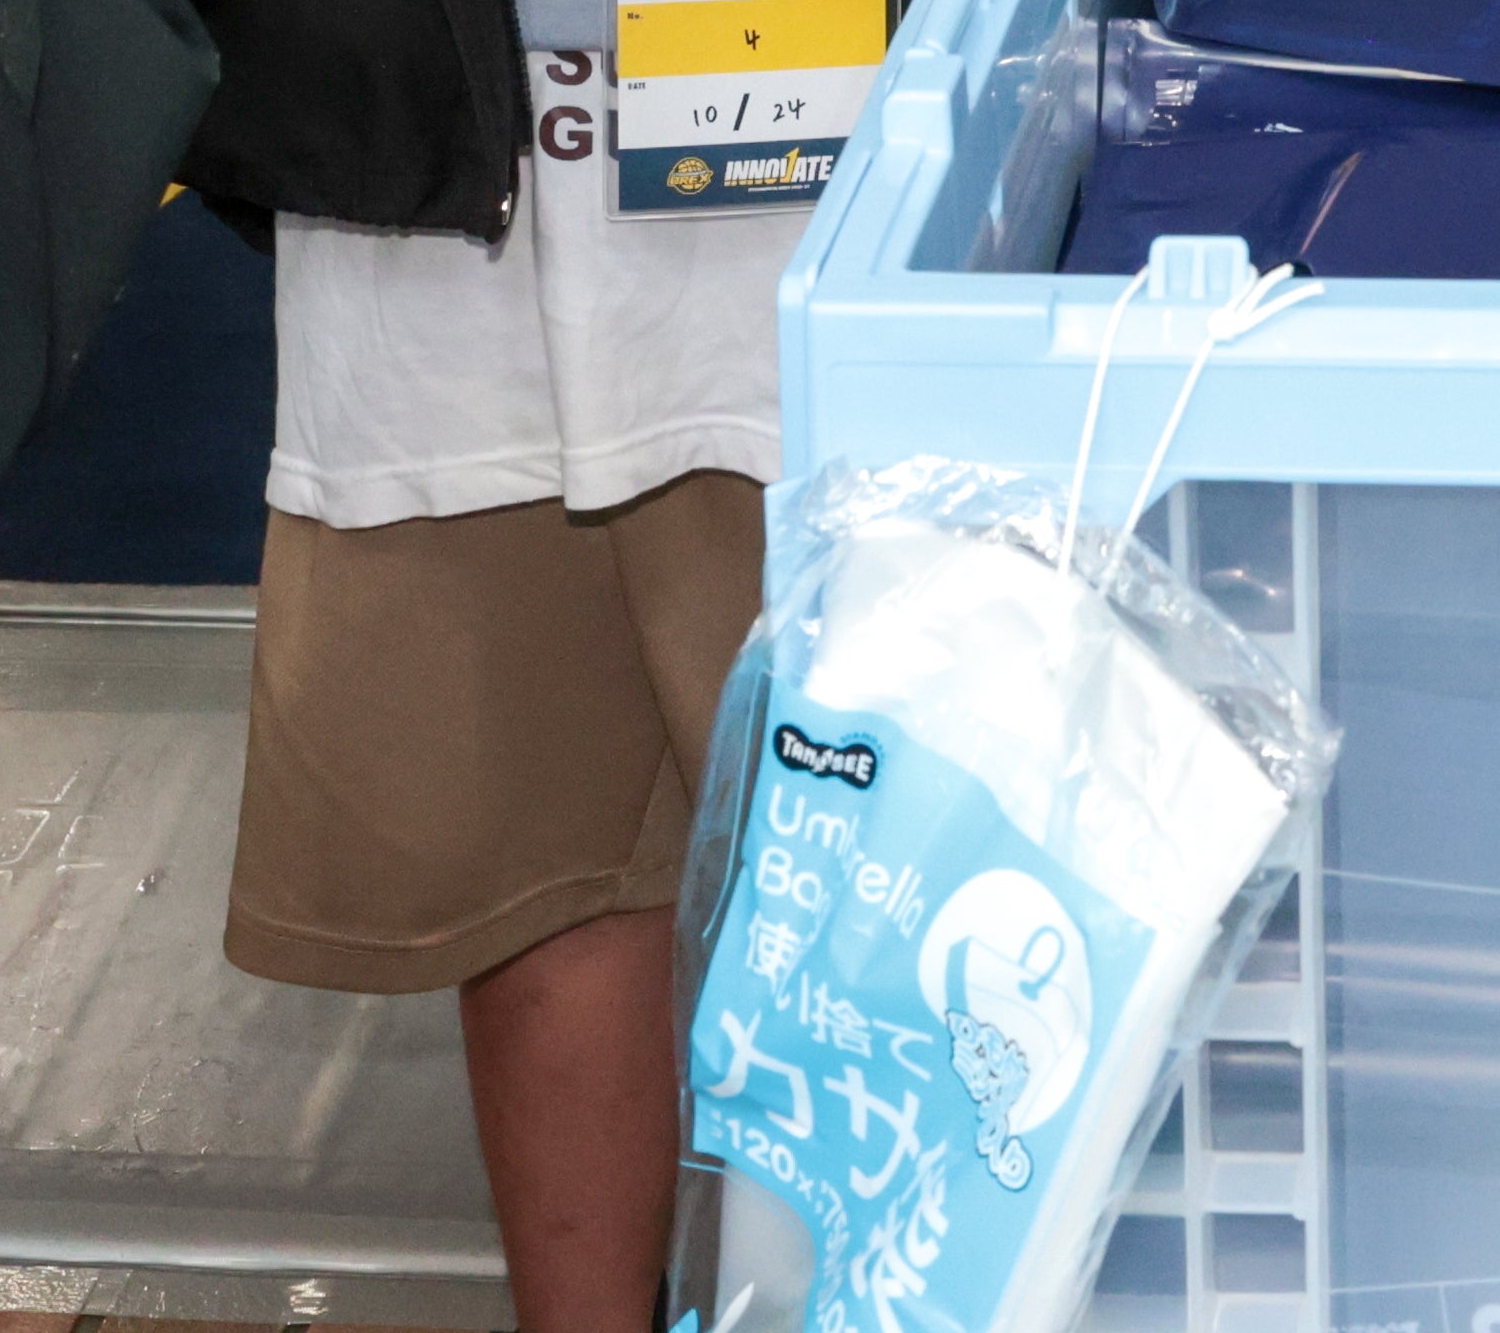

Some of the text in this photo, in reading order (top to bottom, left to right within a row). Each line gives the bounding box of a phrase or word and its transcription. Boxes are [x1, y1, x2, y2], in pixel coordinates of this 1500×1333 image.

[744, 29, 760, 50] 4
[694, 106, 718, 127] 10
[772, 98, 806, 122] 24
